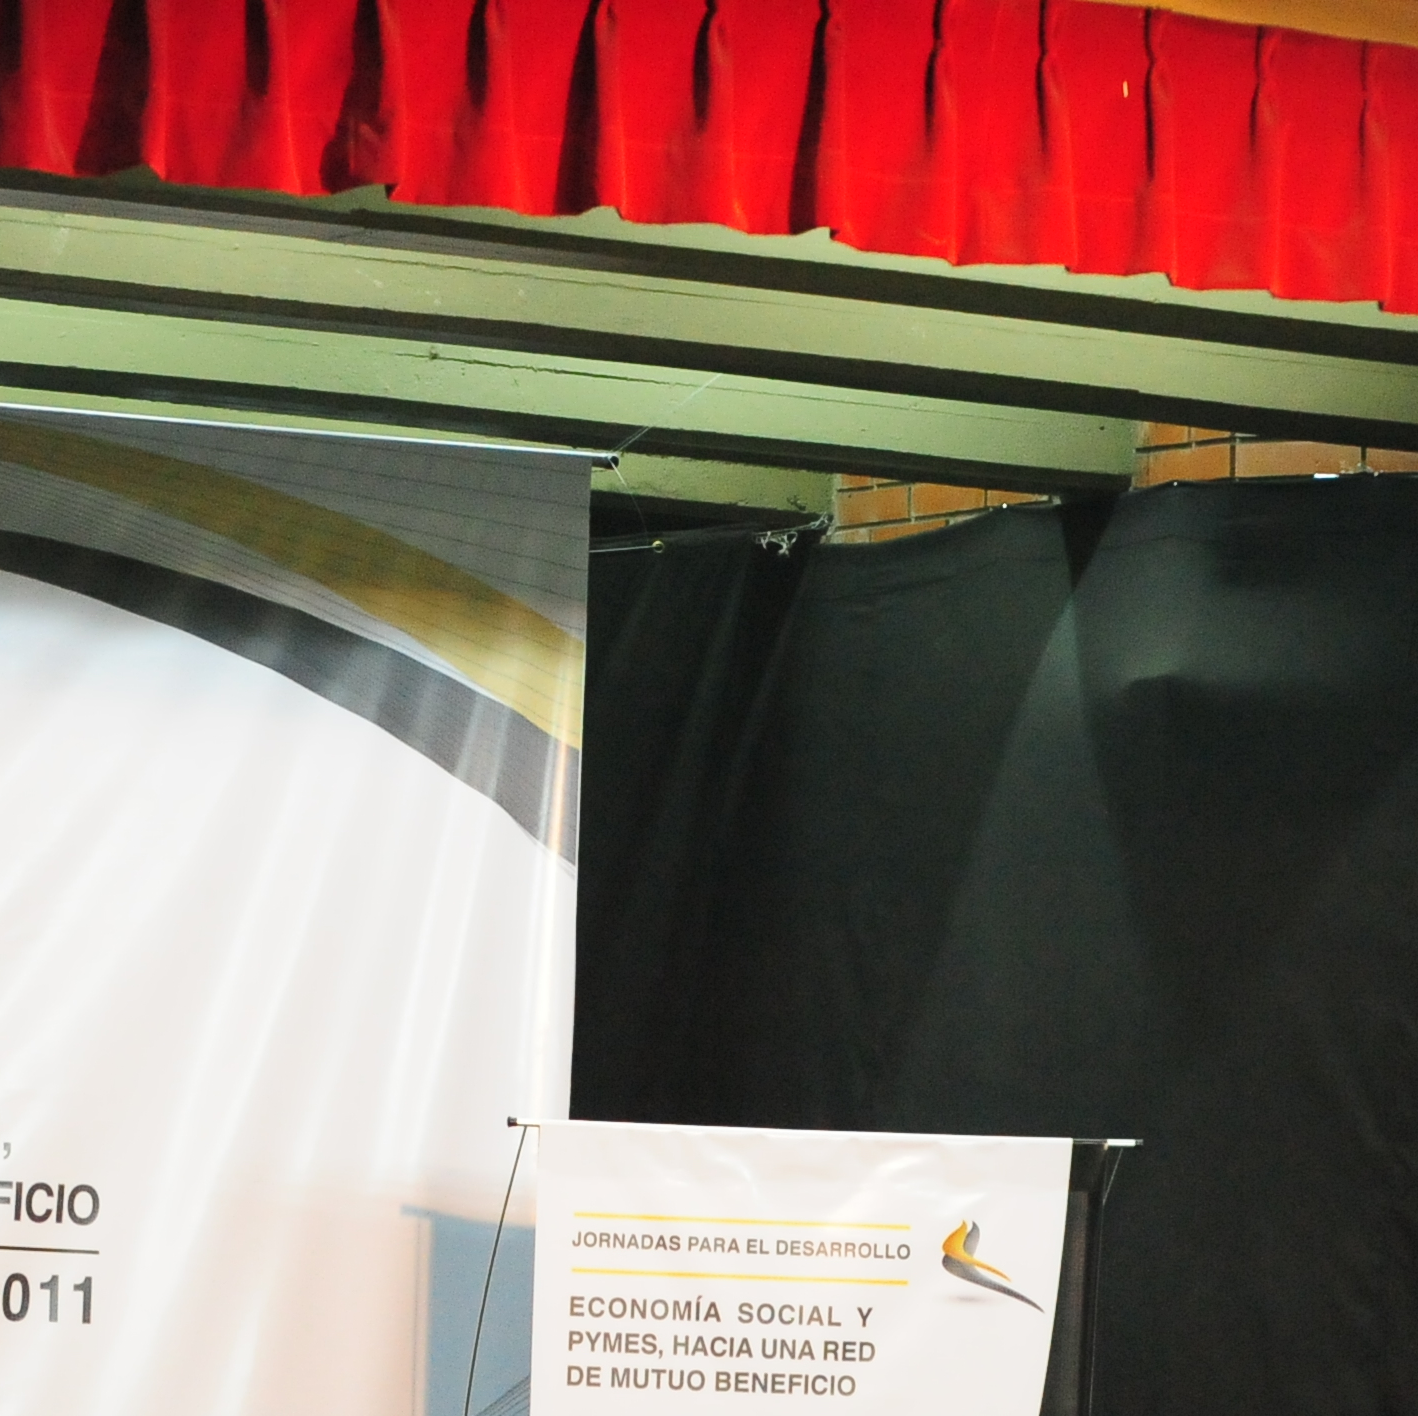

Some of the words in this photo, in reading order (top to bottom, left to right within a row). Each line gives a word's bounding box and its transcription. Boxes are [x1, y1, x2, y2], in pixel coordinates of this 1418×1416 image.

[571, 1230, 682, 1252] JORNADAS
[686, 1236, 741, 1254] PARA
[745, 1238, 770, 1256] EL
[775, 1239, 911, 1260] DESARROLLO
[568, 1295, 722, 1323] ECONOMÍA
[736, 1301, 842, 1327] SOCIAL
[856, 1306, 874, 1328] Y
[567, 1330, 665, 1359] PYMES,
[672, 1334, 754, 1359] HACIA
[760, 1337, 816, 1362] UNA
[822, 1340, 876, 1363] RED
[566, 1364, 602, 1388] DE
[609, 1366, 706, 1391] MUTUO
[714, 1370, 857, 1397] BENEFICIO
